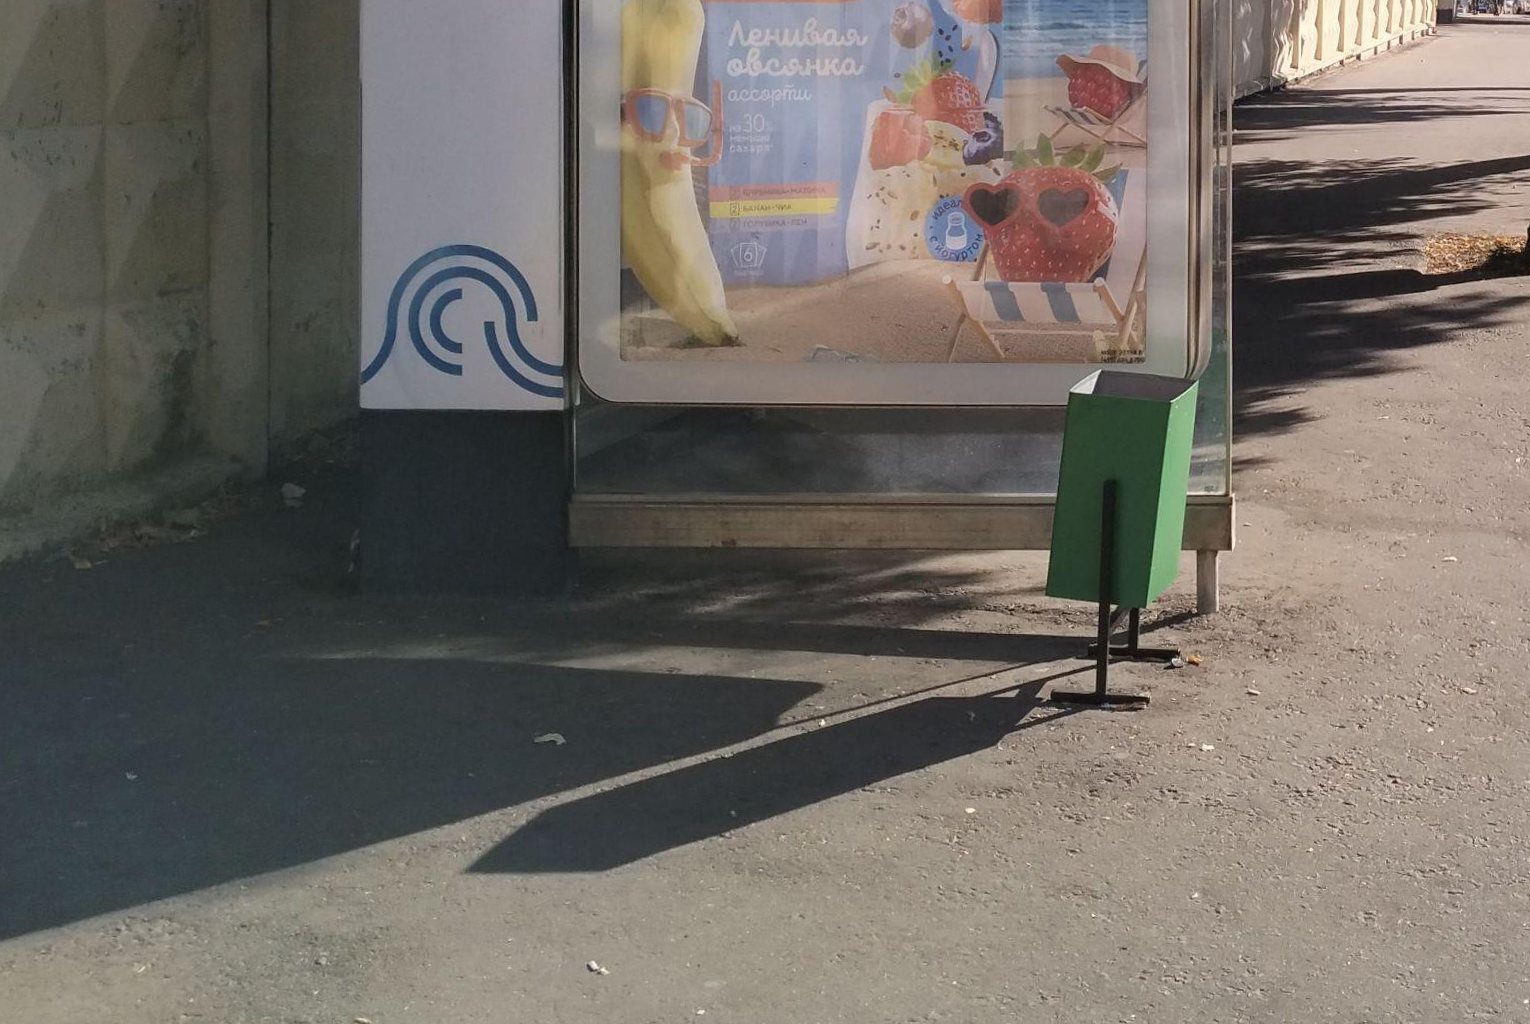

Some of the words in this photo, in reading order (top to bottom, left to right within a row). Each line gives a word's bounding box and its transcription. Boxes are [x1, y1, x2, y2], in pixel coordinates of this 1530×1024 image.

[728, 17, 868, 47] Ленивая
[727, 47, 864, 76] овсянка
[727, 84, 813, 108] ассорти
[743, 247, 753, 262] 6
